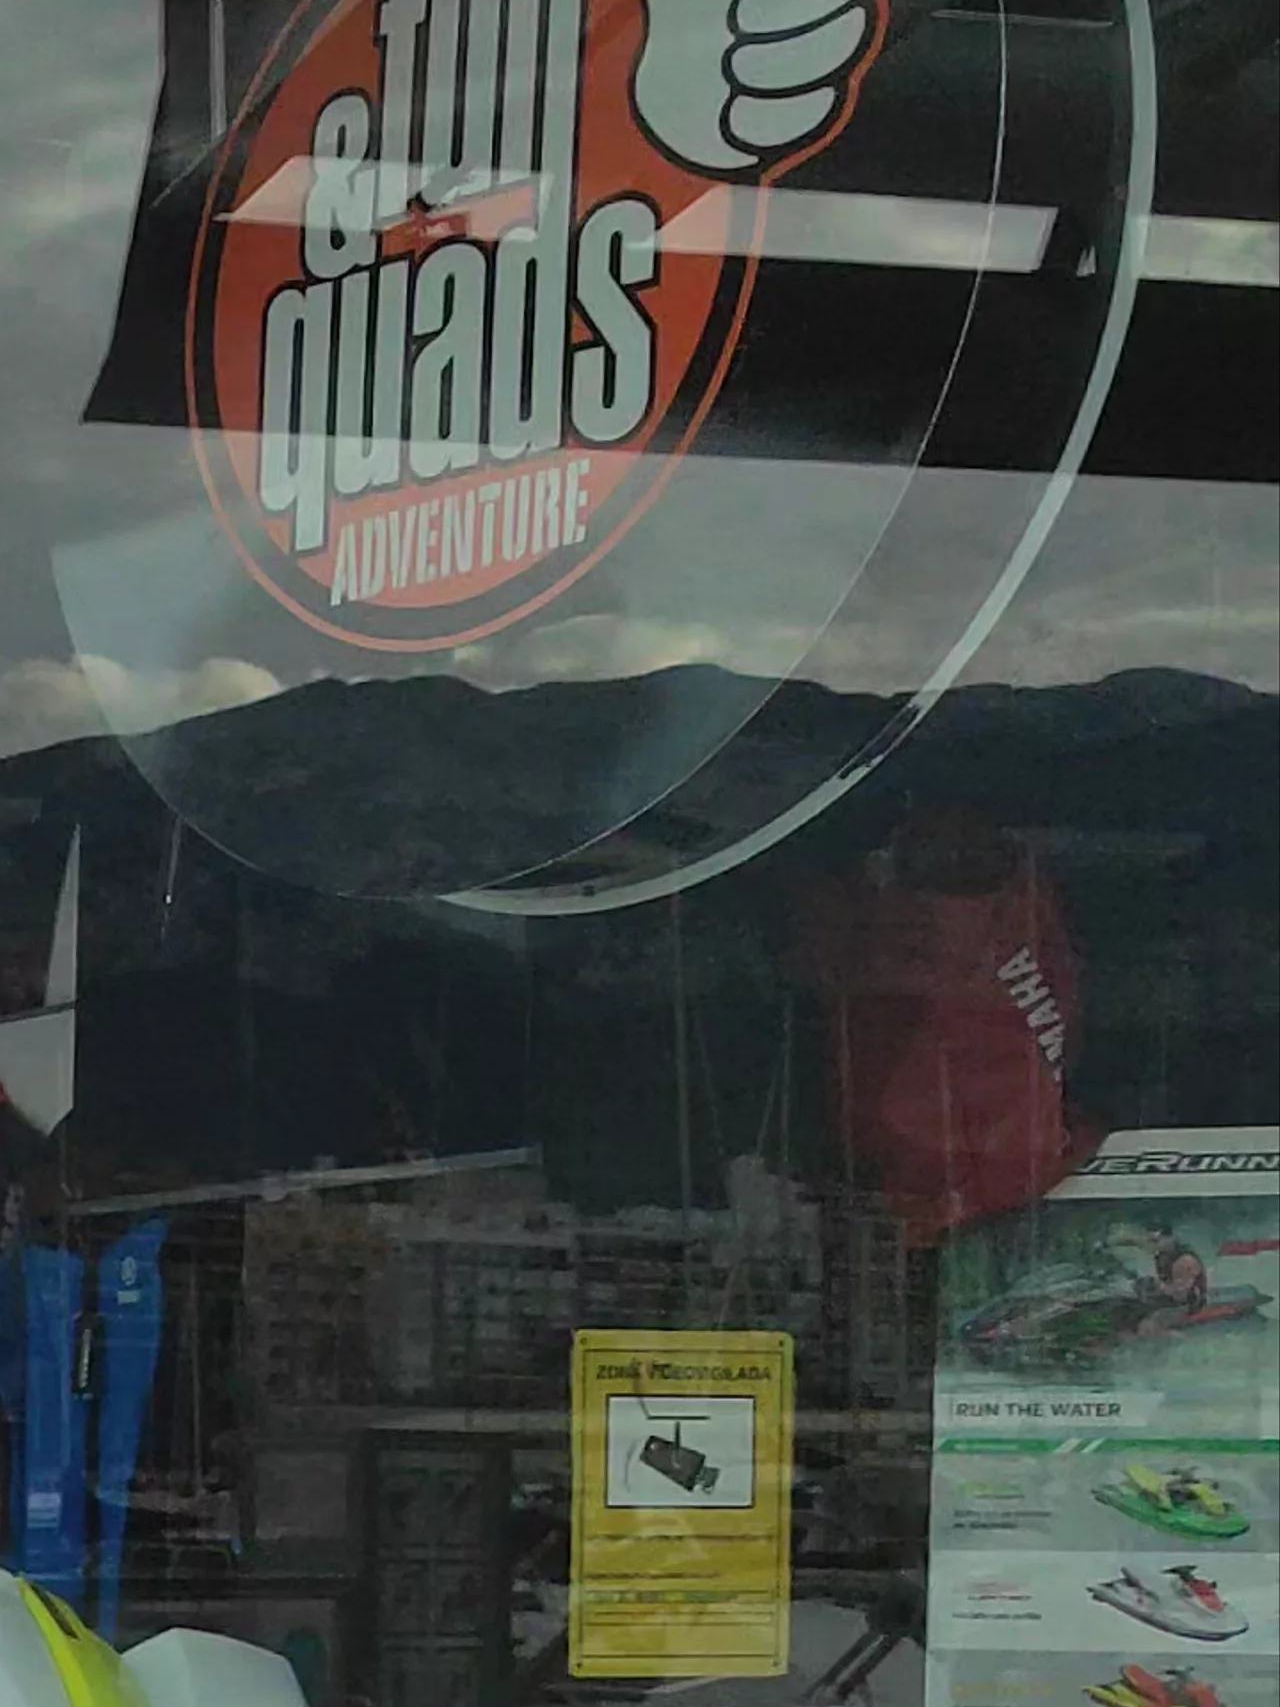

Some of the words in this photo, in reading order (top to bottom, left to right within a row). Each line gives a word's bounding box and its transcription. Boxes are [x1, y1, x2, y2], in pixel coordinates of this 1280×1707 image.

[304, 89, 382, 280] &
[258, 193, 657, 551] quads
[329, 458, 591, 606] ADVENTURE
[955, 1402, 1000, 1418] RUN
[1006, 1402, 1044, 1418] THE
[1050, 1402, 1121, 1418] WATER
